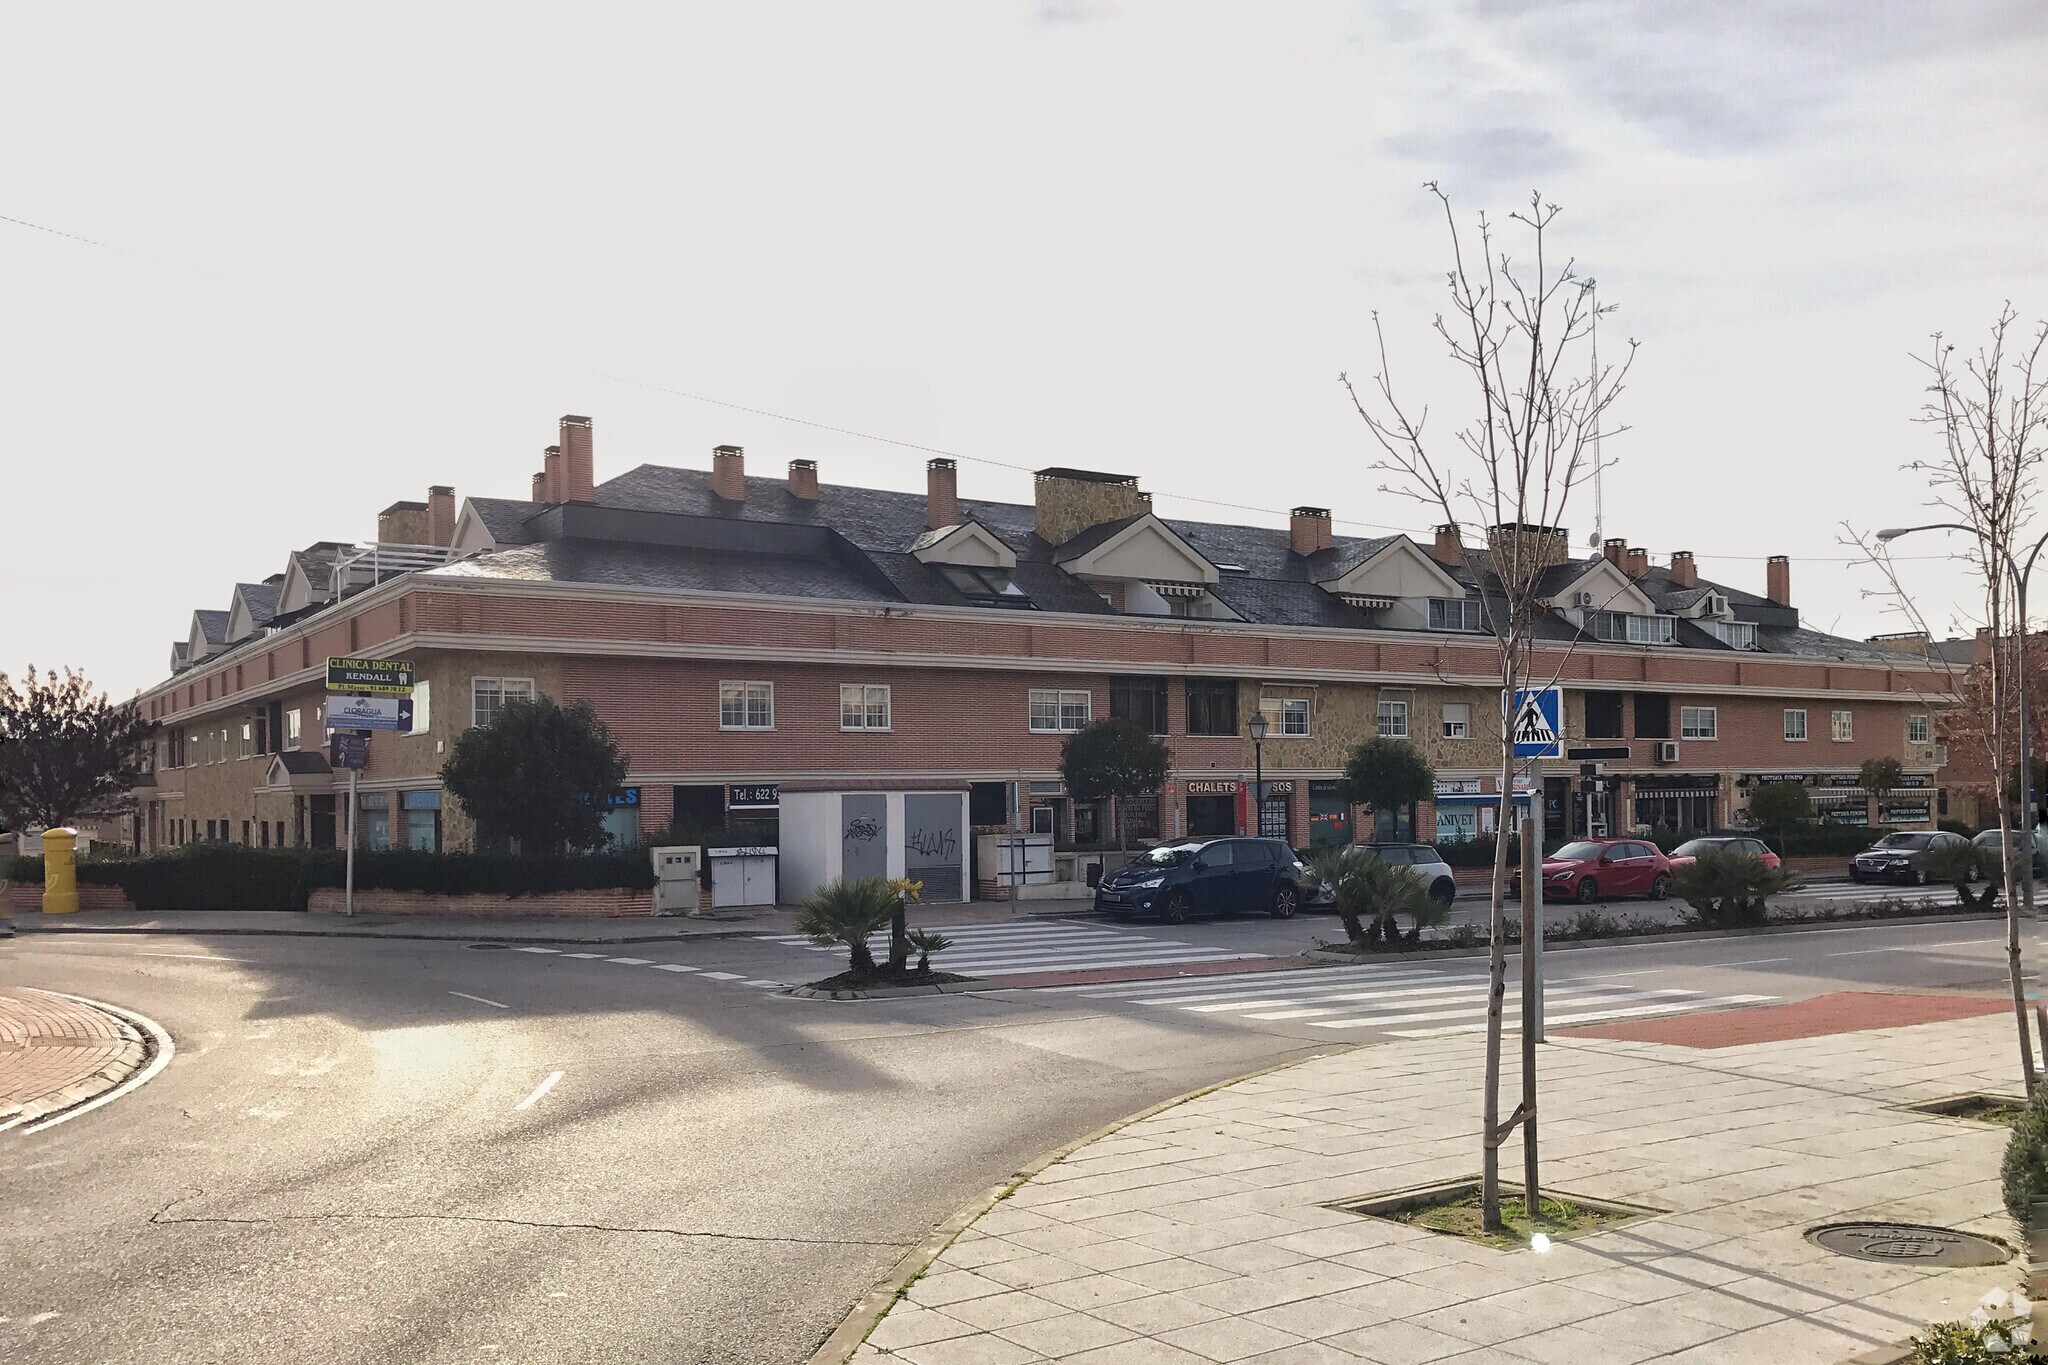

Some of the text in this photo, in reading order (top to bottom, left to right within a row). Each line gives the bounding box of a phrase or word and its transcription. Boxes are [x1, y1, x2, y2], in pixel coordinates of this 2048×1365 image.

[330, 659, 412, 672] CLINICA DENTAL
[346, 672, 392, 682] KENDALL
[1188, 782, 1237, 792] CHALETS
[1271, 782, 1292, 792] SOS
[755, 788, 770, 800] 622
[1437, 814, 1474, 826] ANIVET
